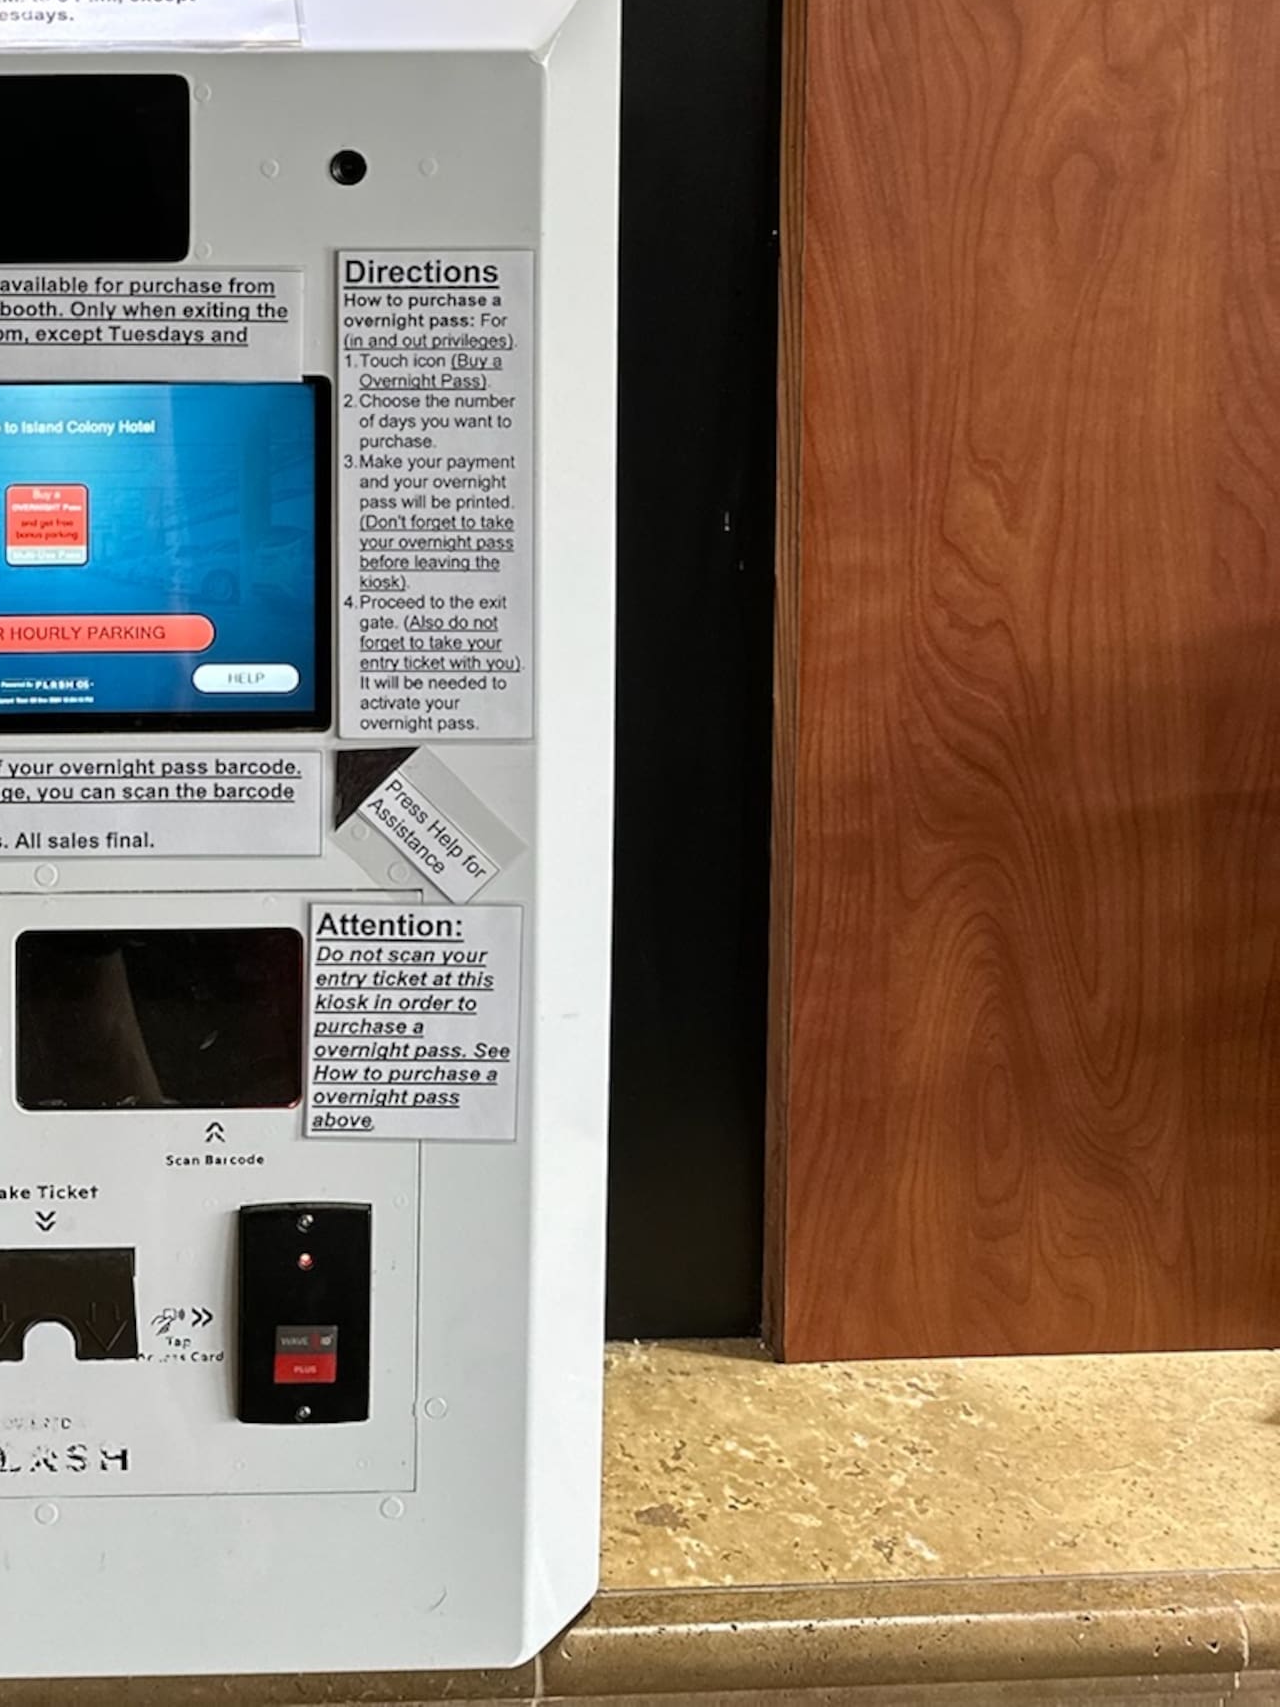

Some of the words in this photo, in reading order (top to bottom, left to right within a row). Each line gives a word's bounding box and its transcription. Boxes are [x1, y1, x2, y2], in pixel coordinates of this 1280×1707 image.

[346, 260, 498, 286] Directions
[0, 276, 88, 294] available
[95, 276, 124, 294] for
[129, 277, 222, 294] purchase
[228, 278, 274, 294] from
[344, 293, 382, 307] How
[386, 294, 403, 307] to
[408, 293, 486, 309] purchase
[492, 296, 501, 306] a
[5, 422, 18, 434] to
[22, 421, 63, 433] Island
[66, 420, 115, 436] Colony
[118, 420, 155, 433] Hotel
[10, 626, 82, 640] HOURLY
[88, 626, 166, 640] PARKING
[226, 672, 265, 685] HELP
[8, 763, 54, 776] your
[60, 759, 154, 776] overnight
[161, 762, 208, 776] pass
[215, 759, 300, 775] barcode.
[367, 798, 445, 874] Assistance
[385, 779, 428, 824] Press
[427, 819, 463, 857] Help
[461, 854, 487, 878] for
[316, 913, 461, 936] Attention:
[316, 946, 344, 963] Do
[350, 948, 383, 963] not
[388, 950, 435, 963] scan
[443, 951, 488, 964] your
[166, 1155, 200, 1166] Scan
[206, 1154, 264, 1165] Barcode
[37, 1185, 98, 1199] Ticket
[191, 1351, 224, 1362] Card
